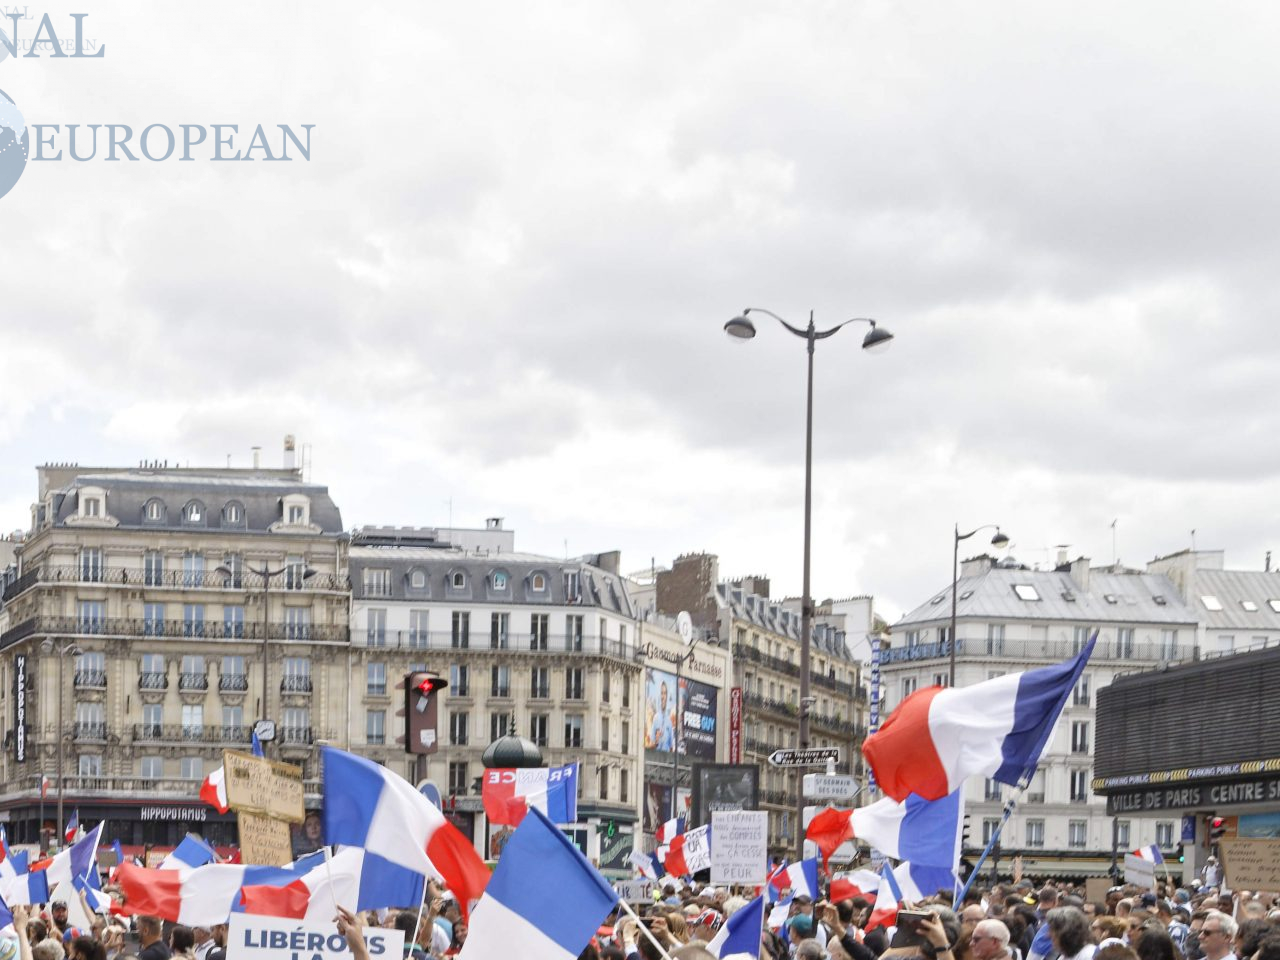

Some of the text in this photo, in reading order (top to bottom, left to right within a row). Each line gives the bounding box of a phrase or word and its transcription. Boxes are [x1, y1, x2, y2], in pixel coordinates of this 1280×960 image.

[17, 656, 25, 761] HIPPOPOTAMUS
[1113, 793, 1142, 811] VILLE
[1145, 791, 1162, 808] DE
[1166, 787, 1200, 806] PARIS
[1210, 782, 1264, 802] CENTRE
[141, 807, 207, 821] HIPPOPOTAMUS
